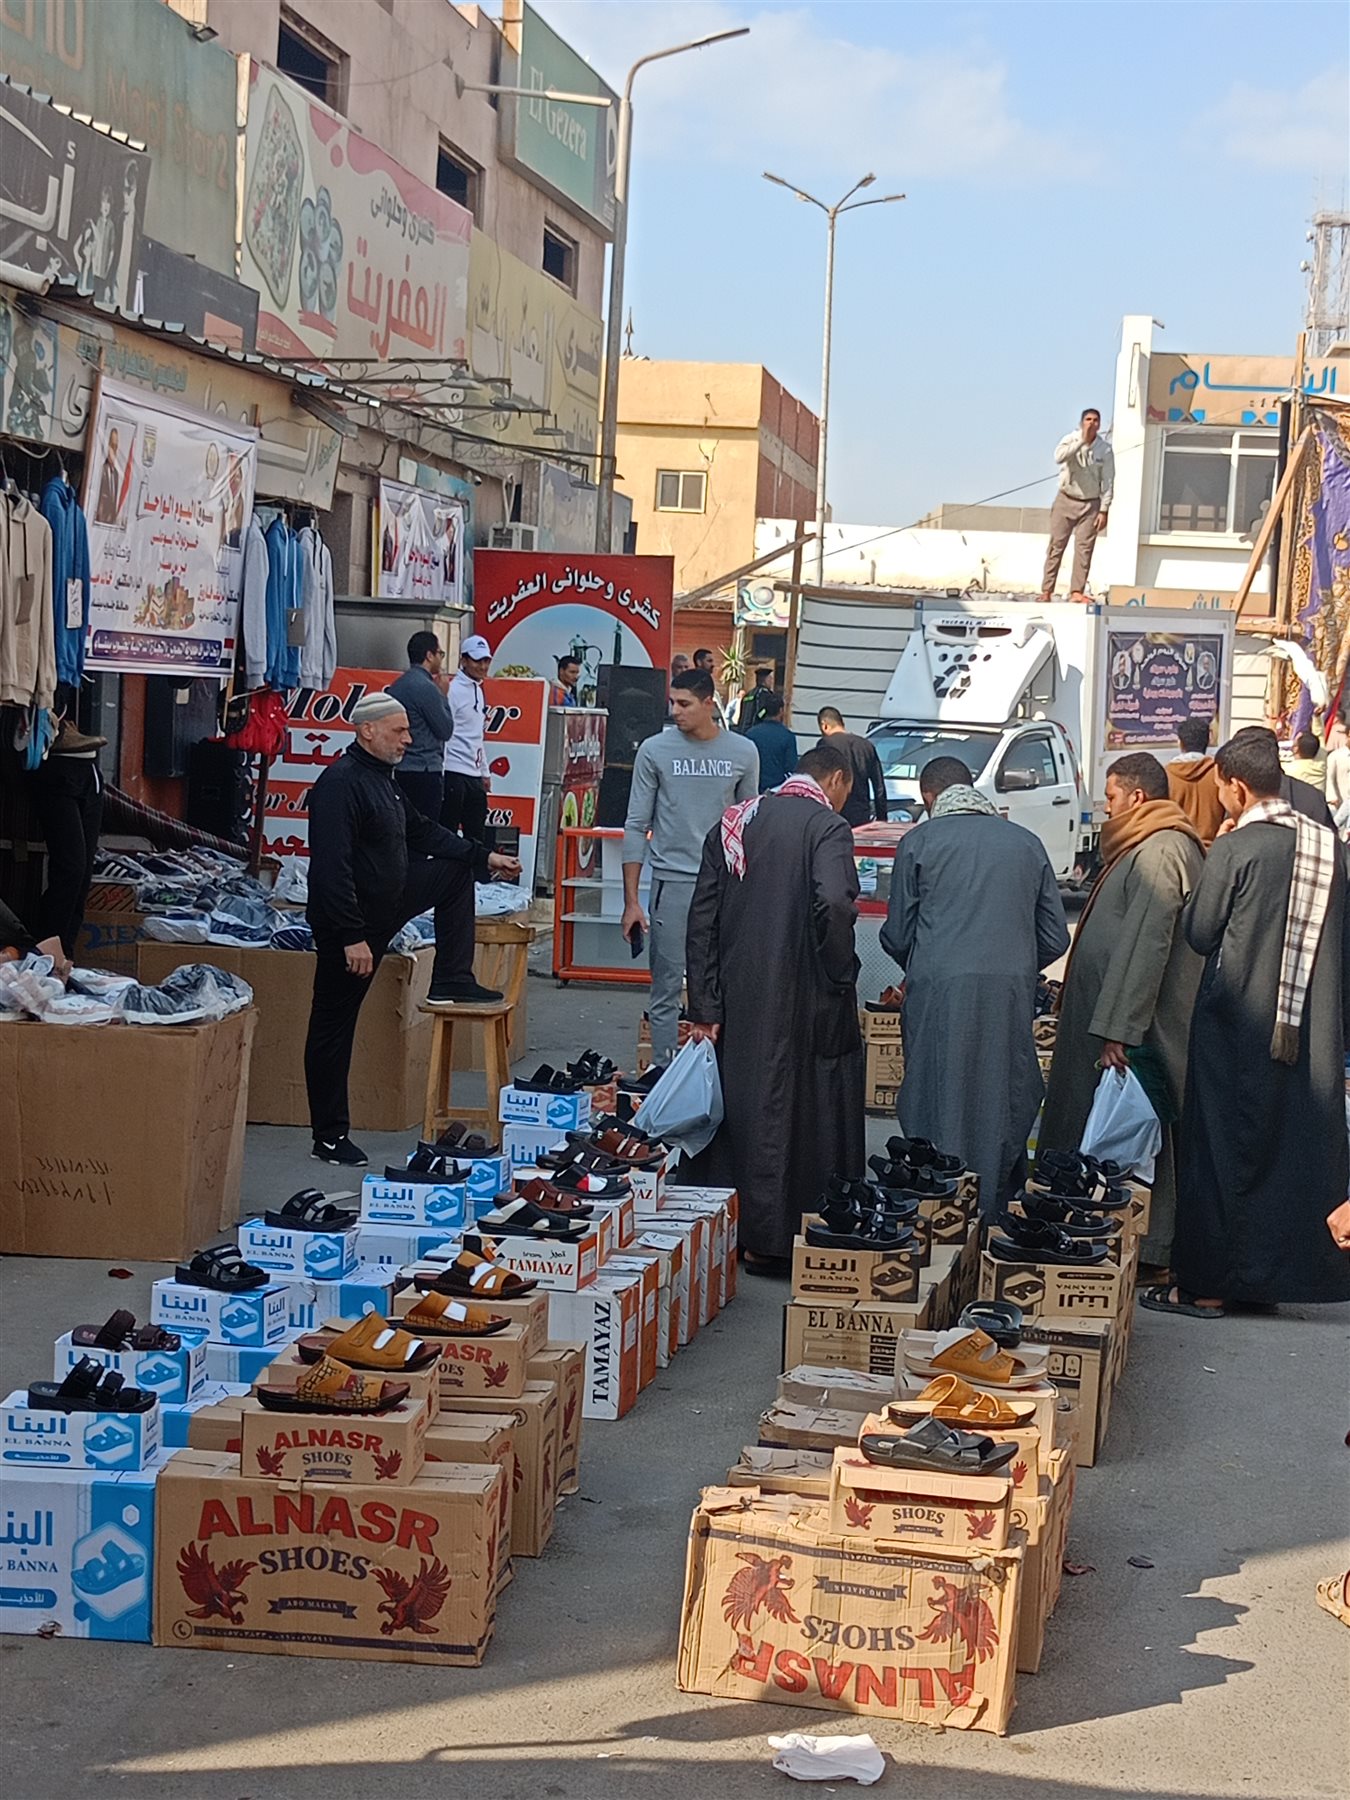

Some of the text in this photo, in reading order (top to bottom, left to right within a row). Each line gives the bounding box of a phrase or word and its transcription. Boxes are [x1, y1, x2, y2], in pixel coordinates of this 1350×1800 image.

[529, 66, 588, 161] El Gezera
[346, 236, 448, 359] العفريت
[487, 571, 547, 624] العفريت
[617, 588, 661, 630] كشرى
[672, 758, 733, 777] BALANCE
[372, 1187, 413, 1203] البنا
[249, 1233, 292, 1251] البنا
[507, 1258, 574, 1276] TAMAYAZ
[805, 1256, 856, 1275] البنا
[162, 1294, 207, 1315] البنا
[1059, 1290, 1109, 1309] البنا
[807, 1310, 895, 1334] EL BANNA
[592, 1300, 612, 1405] TAMAYAZ
[8, 1415, 67, 1438] البنا
[4, 1437, 73, 1448] EL BANNA
[274, 1429, 384, 1454] ALNASR
[302, 1451, 354, 1466] SHOES
[196, 1494, 440, 1556] ALNASR
[892, 1507, 946, 1525] SHOES
[0, 1510, 53, 1556] البن
[7, 1559, 59, 1574] BANNA
[259, 1546, 373, 1581] SHOES
[800, 1615, 916, 1652] SHOES
[730, 1640, 977, 1710] ALNASR
